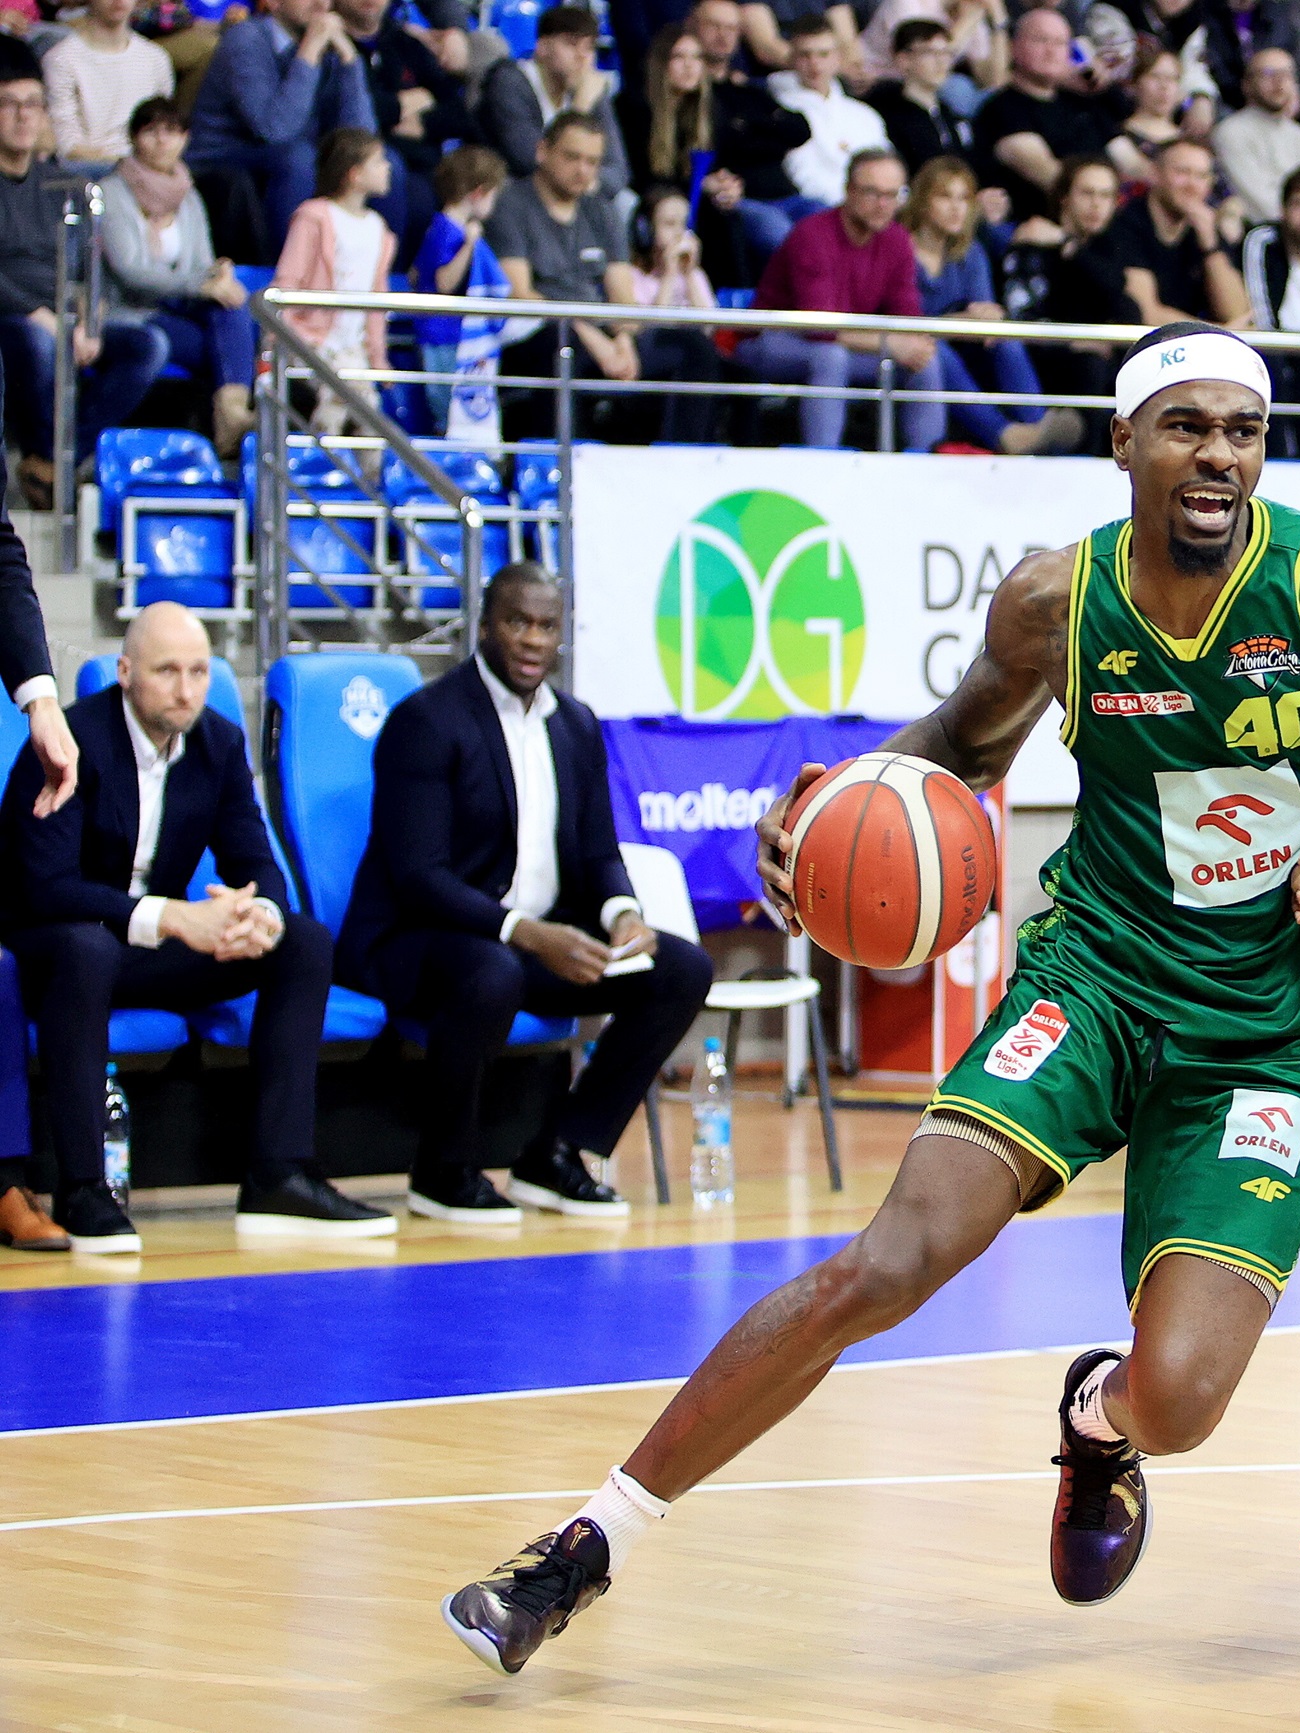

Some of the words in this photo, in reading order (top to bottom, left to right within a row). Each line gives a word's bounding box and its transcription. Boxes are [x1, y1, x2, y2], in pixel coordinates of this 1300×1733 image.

[1160, 347, 1186, 369] KC
[1097, 650, 1139, 675] 4F
[1096, 698, 1139, 711] OREN
[638, 782, 778, 832] molten
[1191, 845, 1292, 886] ORLEN
[1031, 1013, 1065, 1031] ORLEN
[997, 1061, 1018, 1075] Liga
[1234, 1135, 1291, 1158] ORLEN
[1240, 1176, 1292, 1203] 4F
